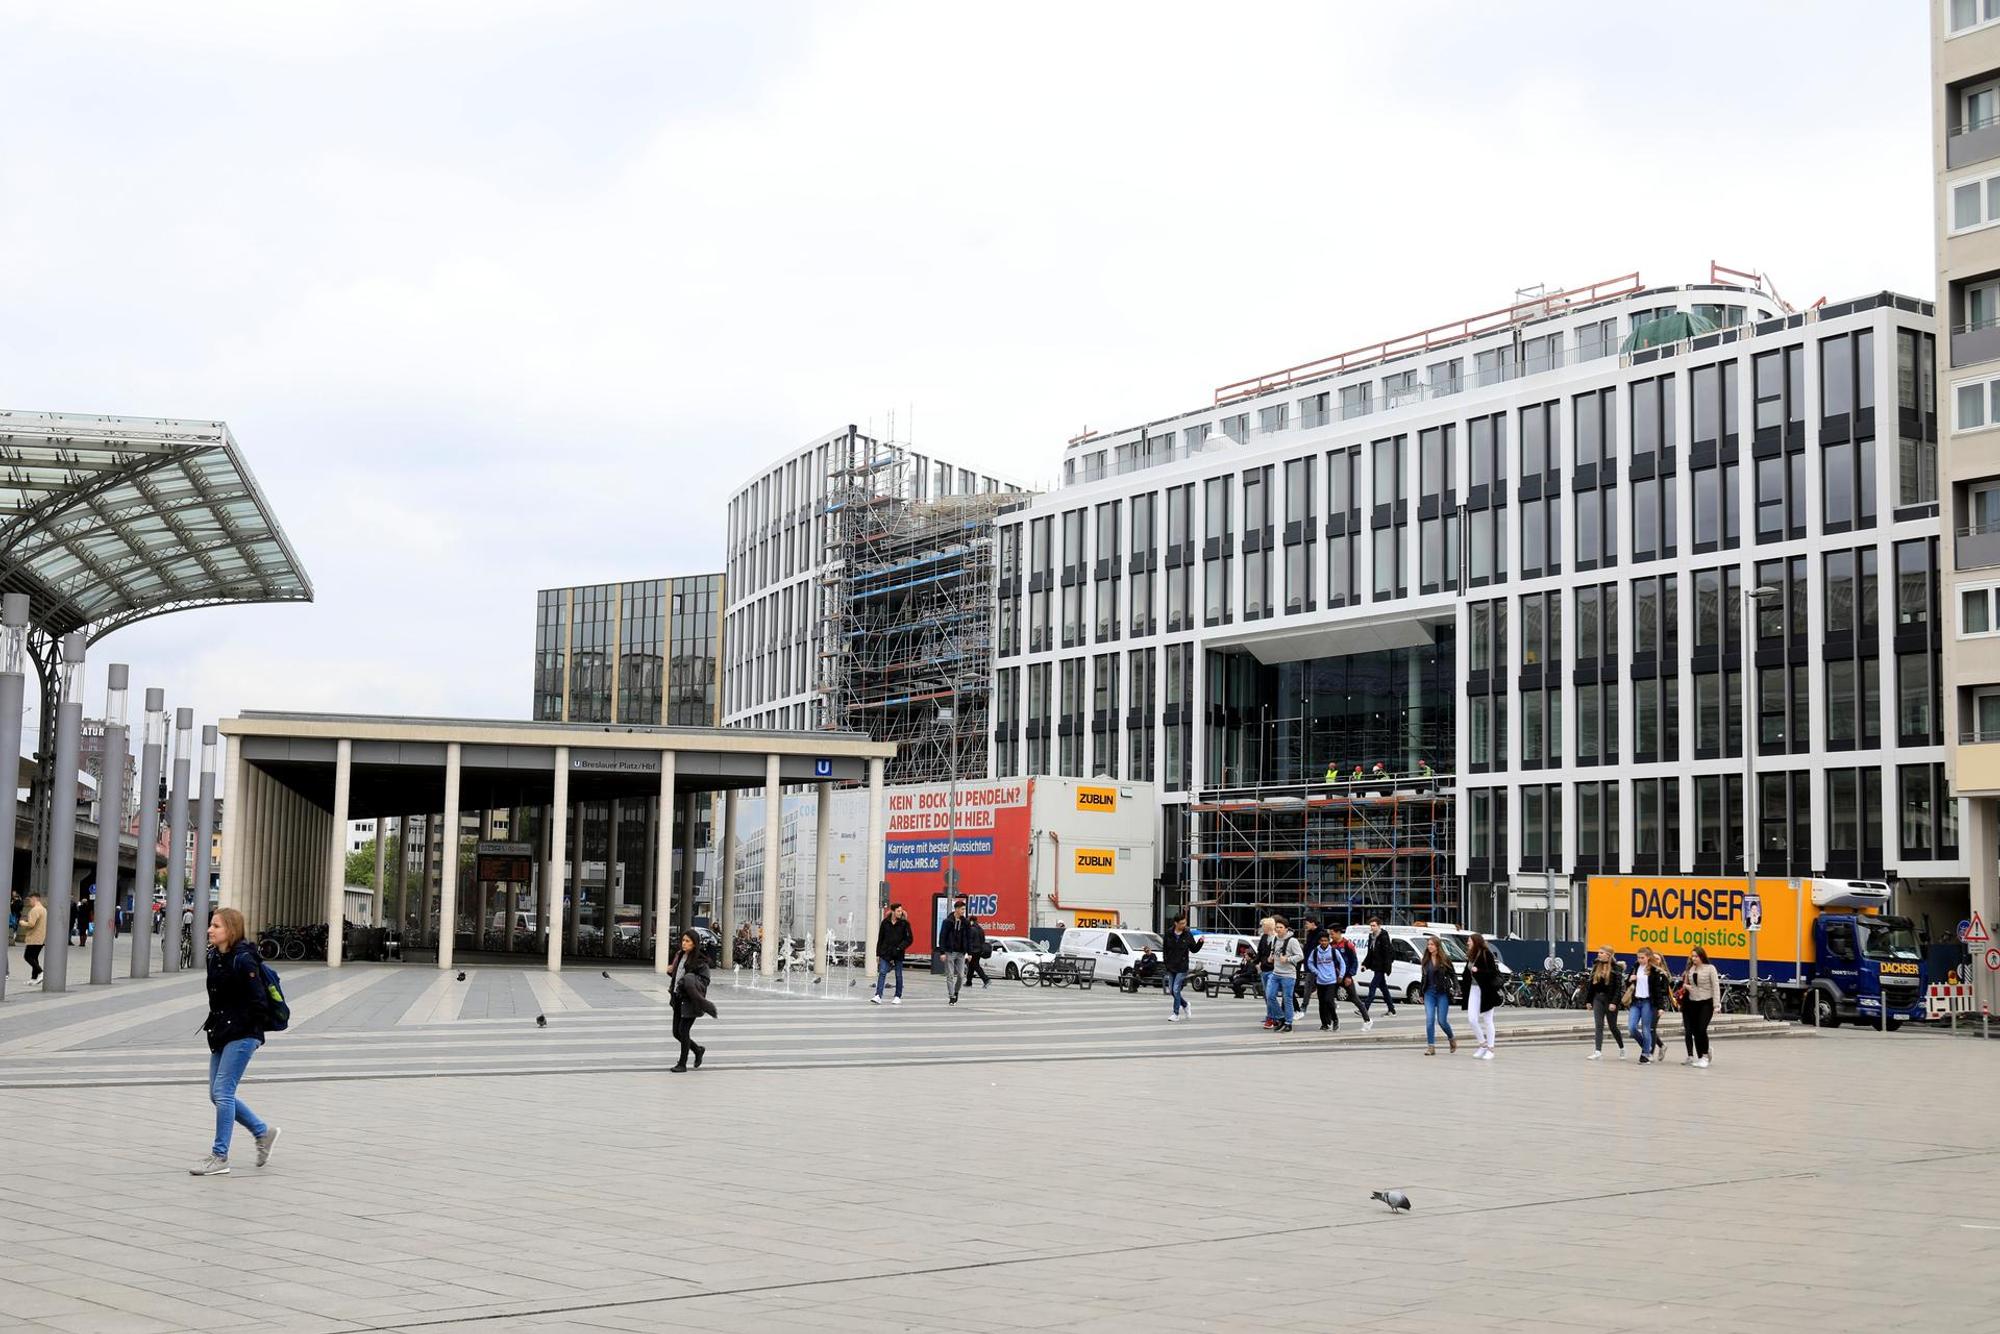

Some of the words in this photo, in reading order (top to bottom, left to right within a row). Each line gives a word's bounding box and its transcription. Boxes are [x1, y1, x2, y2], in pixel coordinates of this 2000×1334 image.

[82, 727, 105, 737] ATUR
[582, 761, 617, 769] Breslauer
[620, 762, 656, 770] Platz/Hbf
[818, 761, 830, 774] U
[919, 792, 947, 809] BOCK
[966, 787, 1021, 806] PENDELN?
[889, 813, 931, 830] ARBEITE
[934, 811, 962, 828] DOH
[965, 810, 992, 827] HIER.
[888, 843, 915, 855] Karriere
[916, 842, 928, 853] mit
[952, 841, 991, 852] Aussichten
[888, 859, 899, 869] auf
[899, 858, 939, 871] jobs.HRS.de
[968, 894, 998, 916] HRS
[1631, 888, 1745, 921] DACHSER
[997, 922, 1016, 932] happen
[1631, 924, 1668, 944] Food
[1673, 926, 1746, 948] Logistics
[1880, 961, 1919, 975] DACHSER
